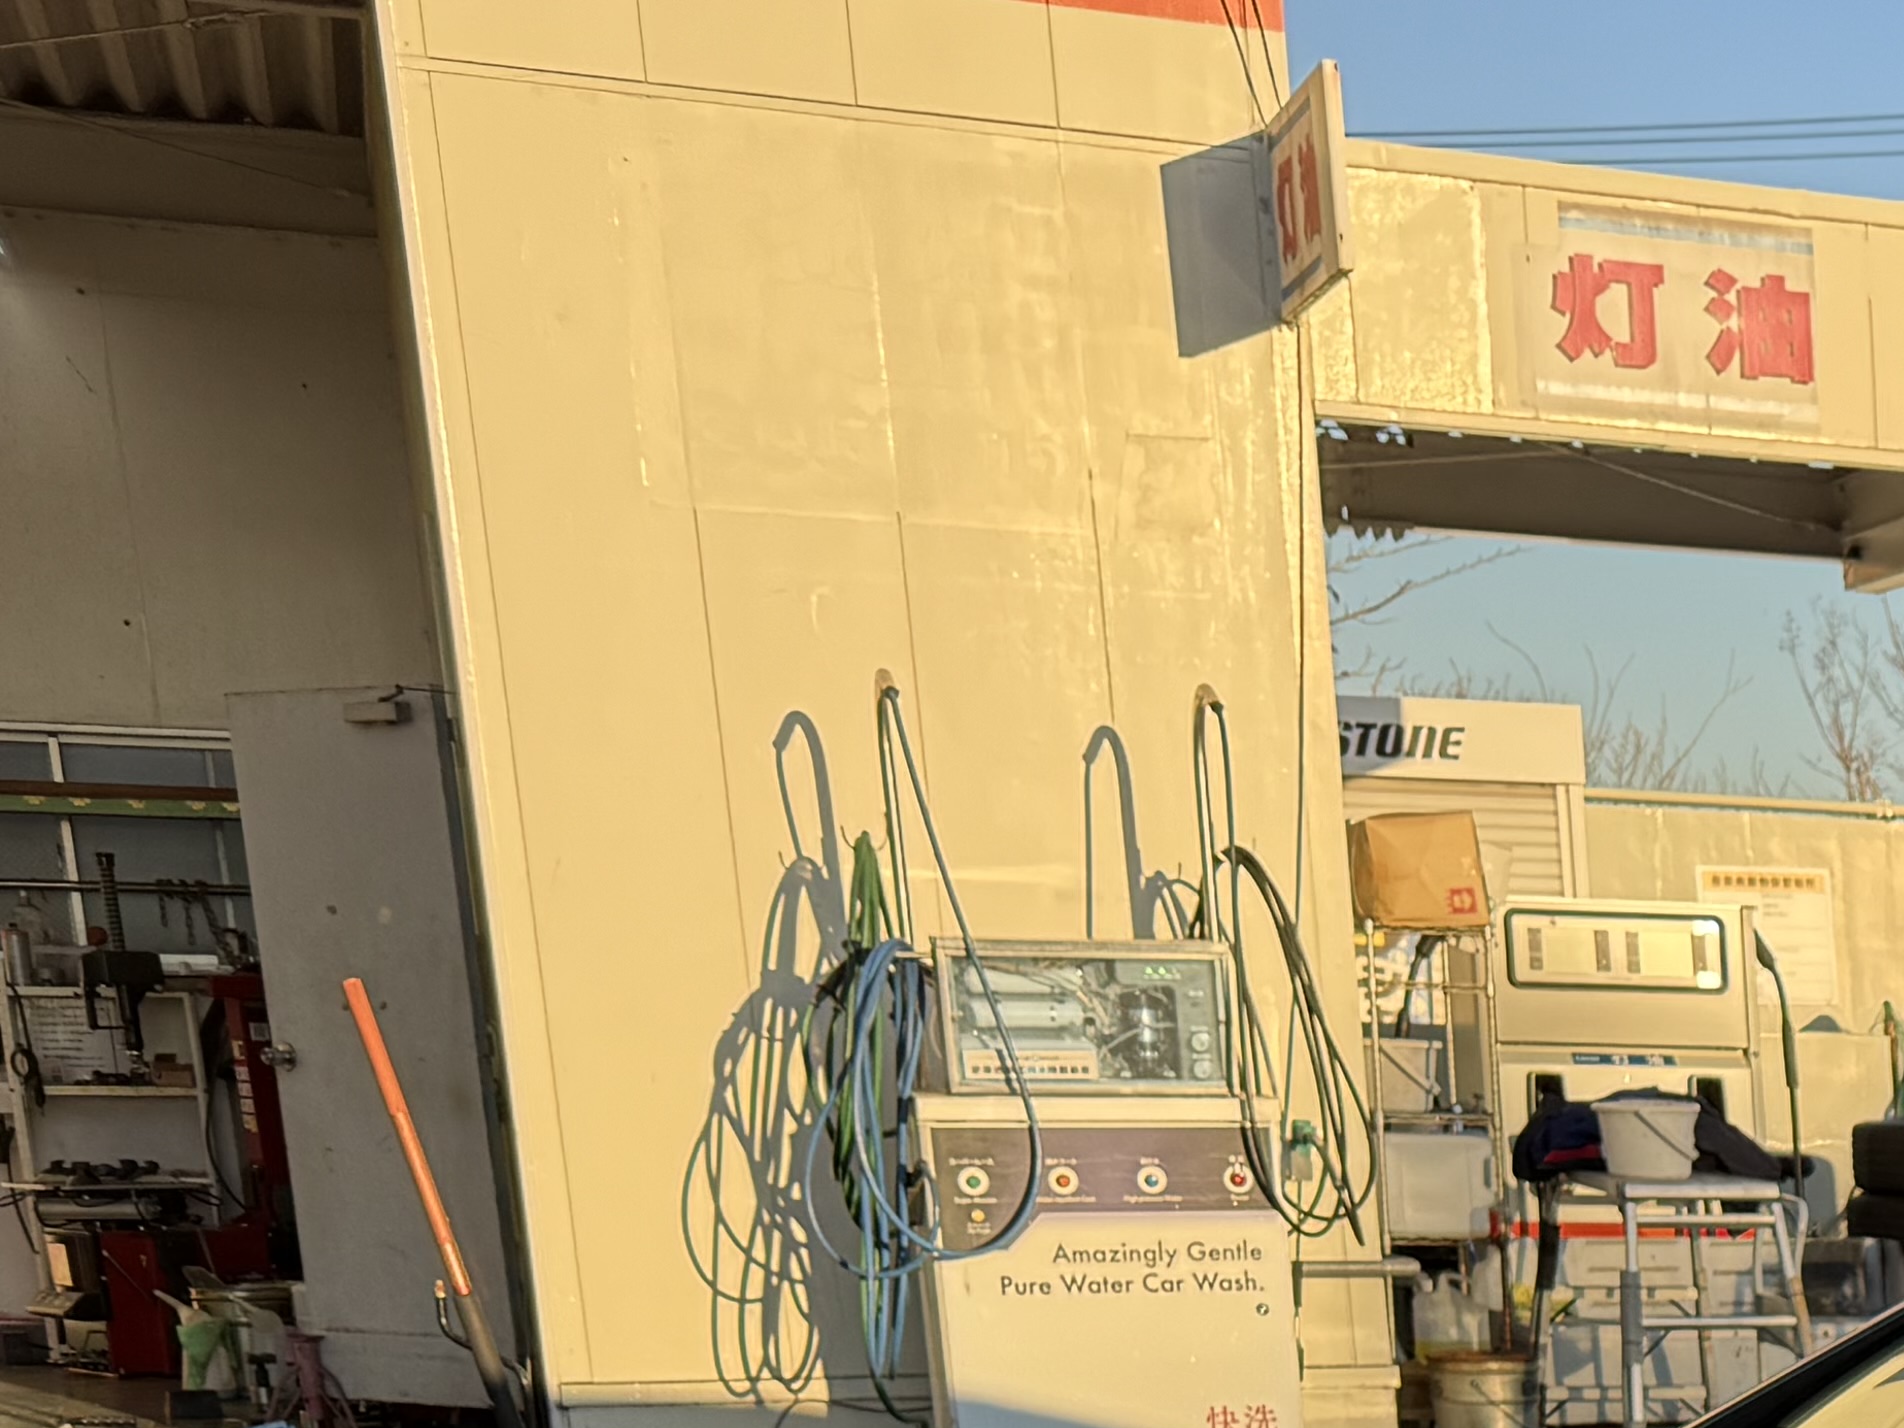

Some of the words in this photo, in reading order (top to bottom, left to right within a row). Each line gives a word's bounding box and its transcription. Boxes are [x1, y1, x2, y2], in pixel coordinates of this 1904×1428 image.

[1550, 253, 1815, 385] 灯油
[1052, 1242, 1177, 1268] Amazingly
[1186, 1240, 1263, 1263] Gentle
[1000, 1275, 1052, 1296] Pure
[1060, 1273, 1135, 1295] Water
[1143, 1273, 1185, 1292] Car
[1193, 1269, 1266, 1293] Wash.
